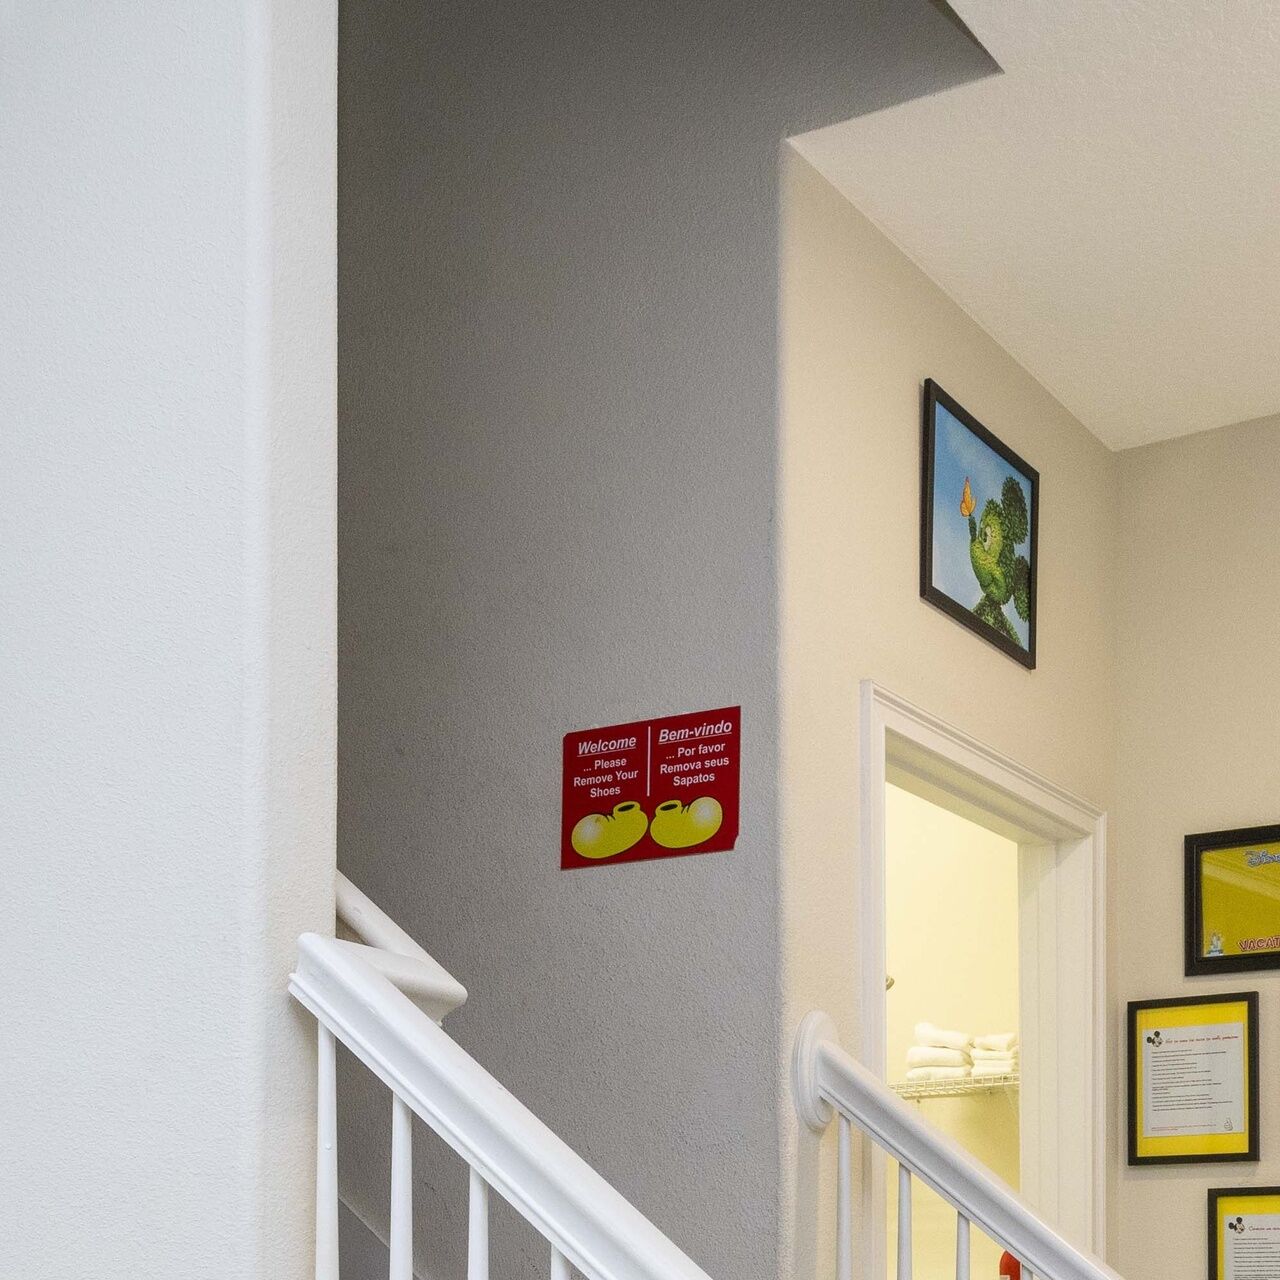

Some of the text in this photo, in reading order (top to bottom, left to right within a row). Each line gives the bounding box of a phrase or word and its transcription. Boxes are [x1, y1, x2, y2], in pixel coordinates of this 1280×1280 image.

[658, 720, 732, 744] Bem-vindo
[577, 736, 637, 757] Welcome
[677, 747, 696, 758] Por
[698, 742, 726, 755] favor
[594, 758, 627, 770] Please
[660, 757, 730, 774] Remova seus
[573, 769, 639, 787] Remove Your
[673, 773, 715, 787] Sapatos
[590, 786, 621, 798] Shoes
